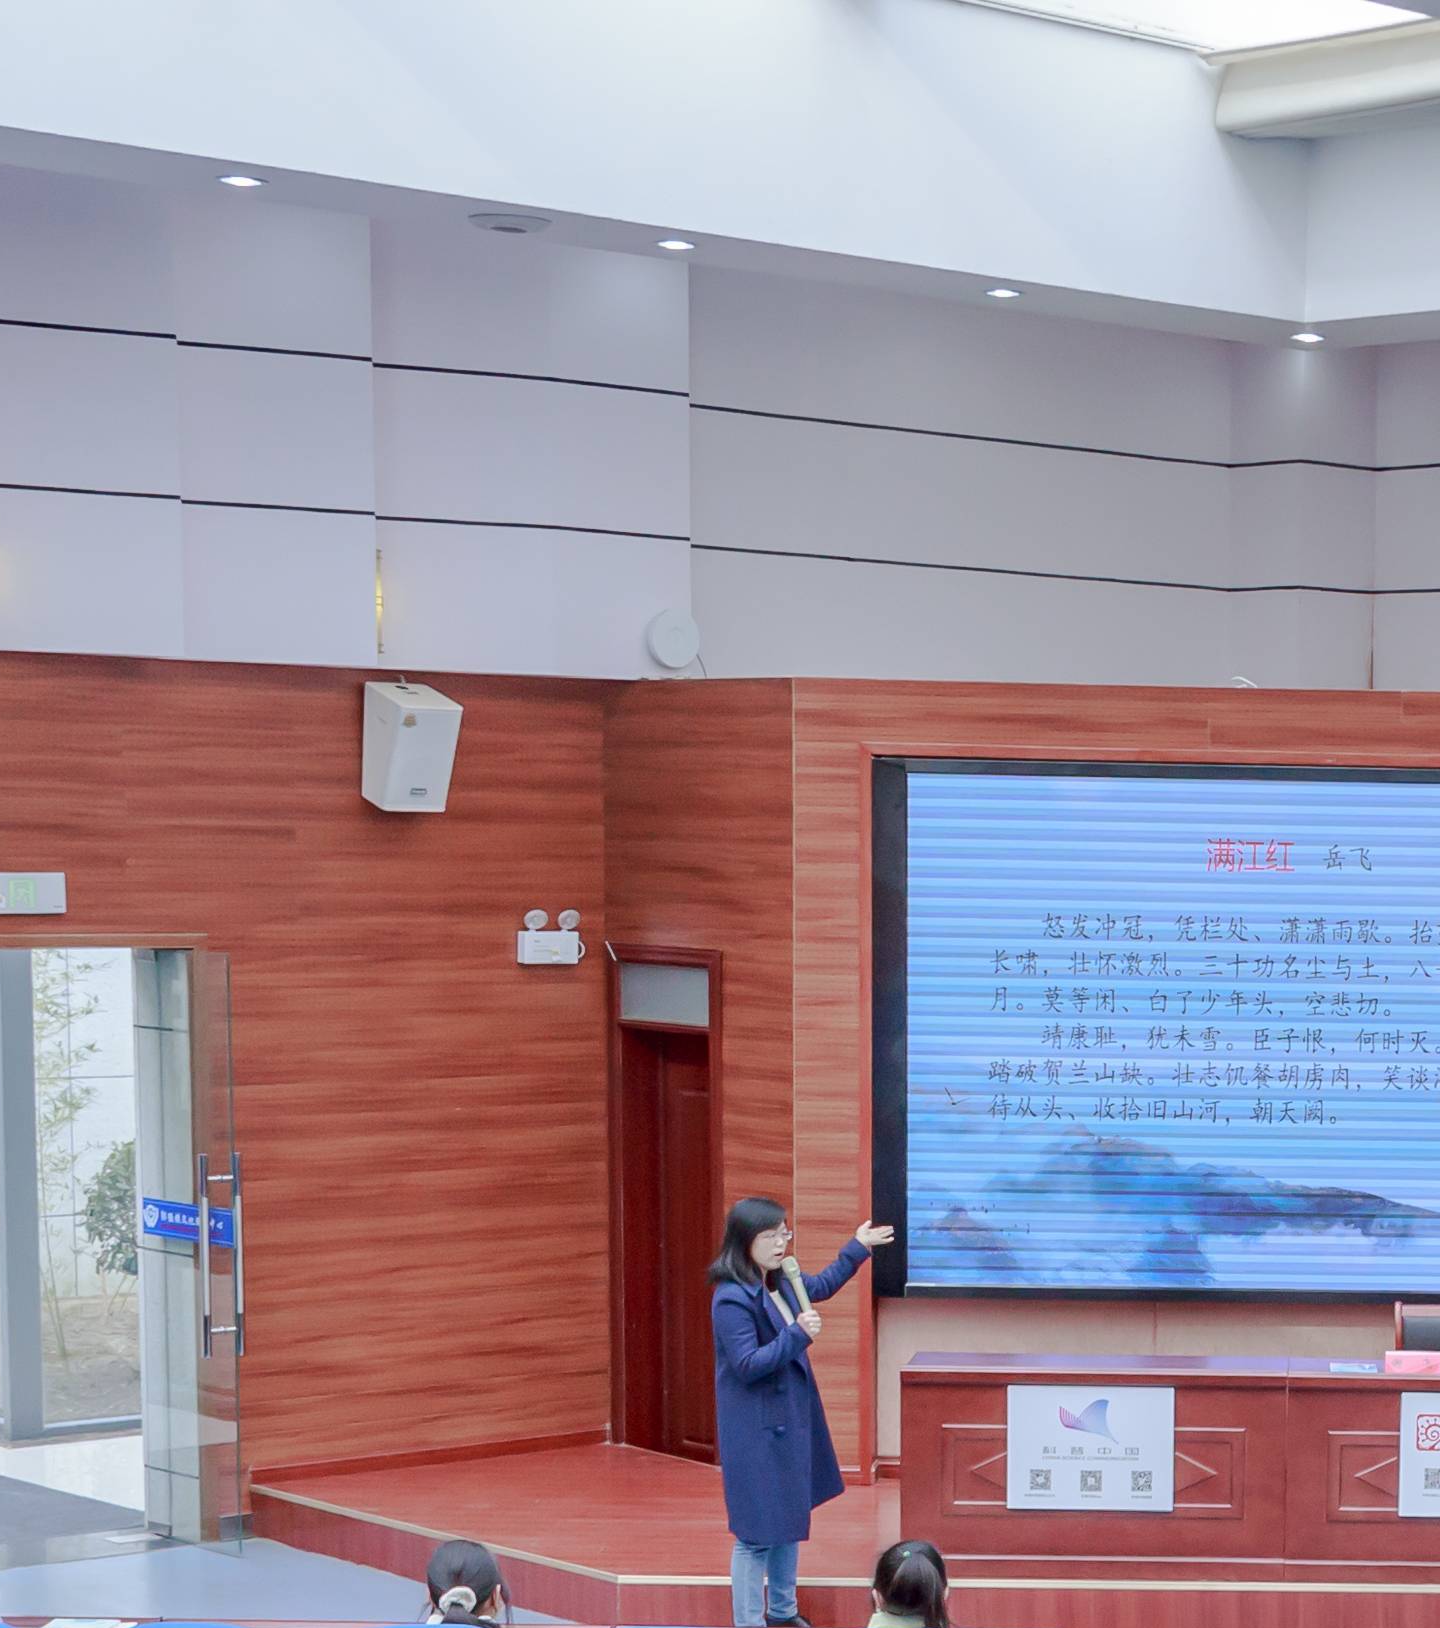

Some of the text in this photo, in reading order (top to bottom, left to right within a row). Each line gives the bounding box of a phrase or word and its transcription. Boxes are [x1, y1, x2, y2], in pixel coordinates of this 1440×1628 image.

[1207, 838, 1372, 873] 满江红 岳飞
